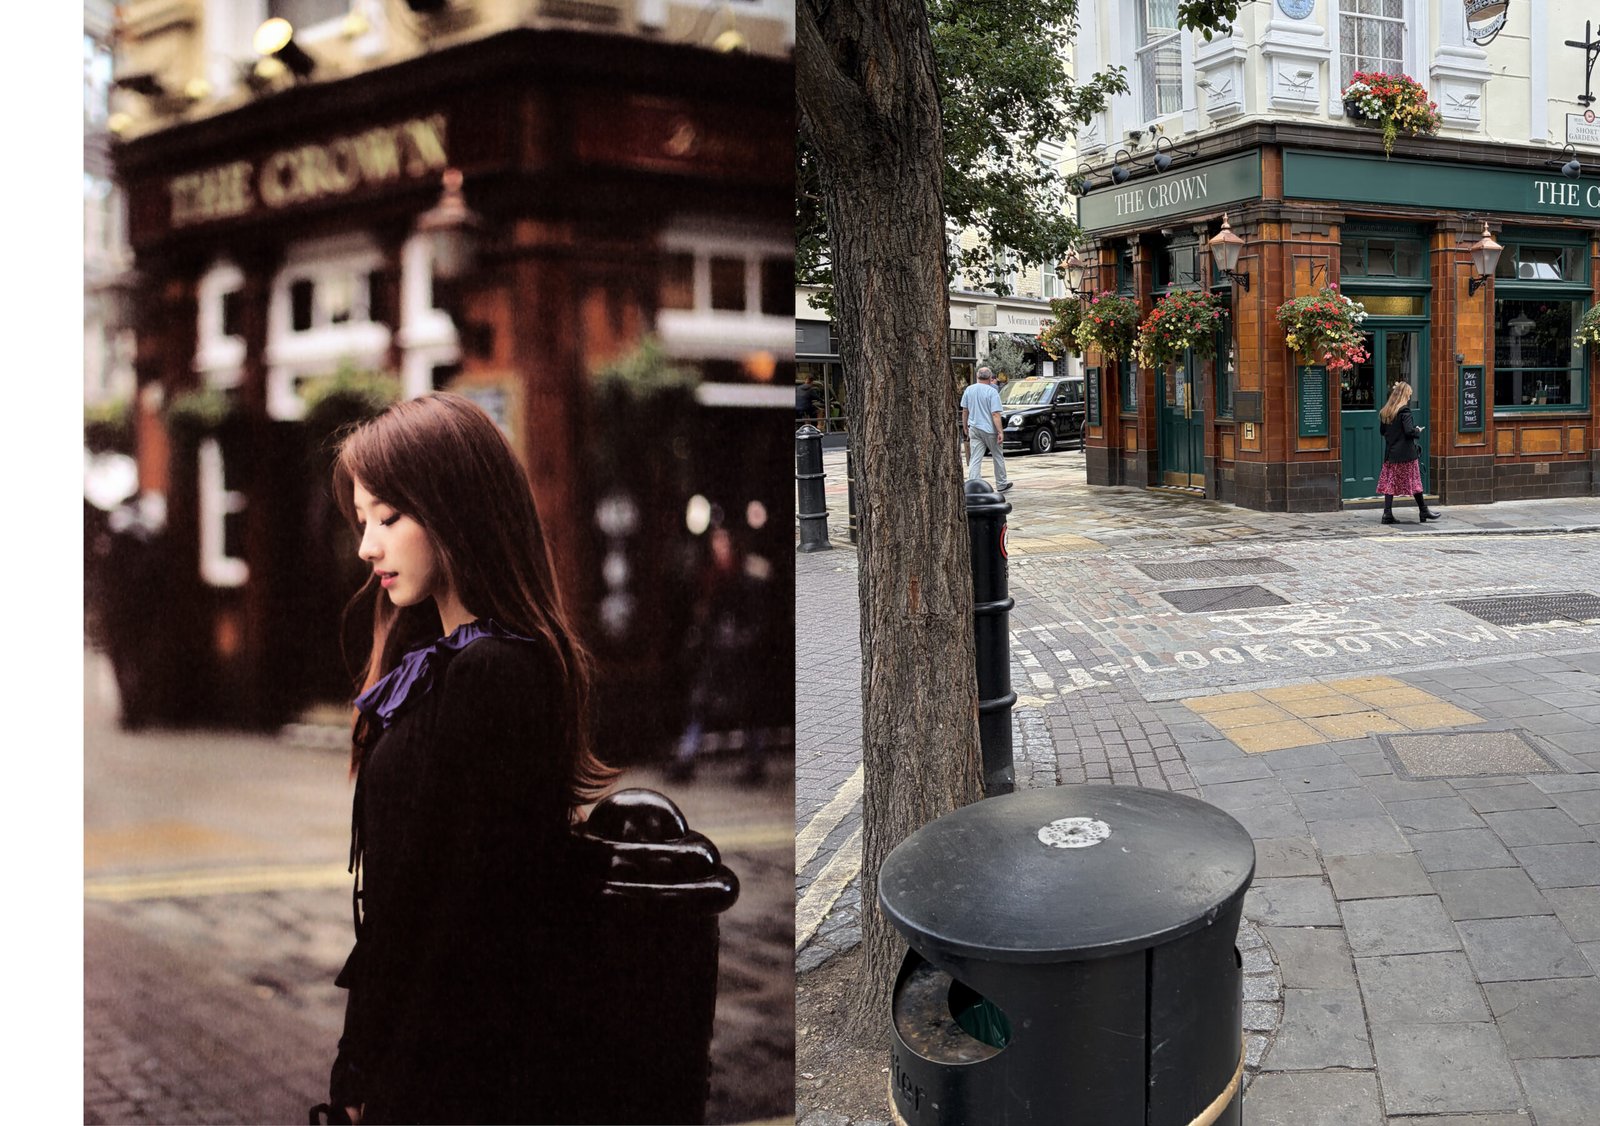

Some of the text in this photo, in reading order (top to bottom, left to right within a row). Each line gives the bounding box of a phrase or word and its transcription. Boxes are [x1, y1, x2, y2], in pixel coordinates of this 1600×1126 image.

[1575, 127, 1600, 136] SHORT
[168, 113, 448, 228] THE CROWN
[1114, 173, 1208, 216] THE CROWN
[1534, 181, 1580, 206] THE
[1132, 643, 1285, 674] LOOK
[1291, 628, 1448, 658] BOTH
